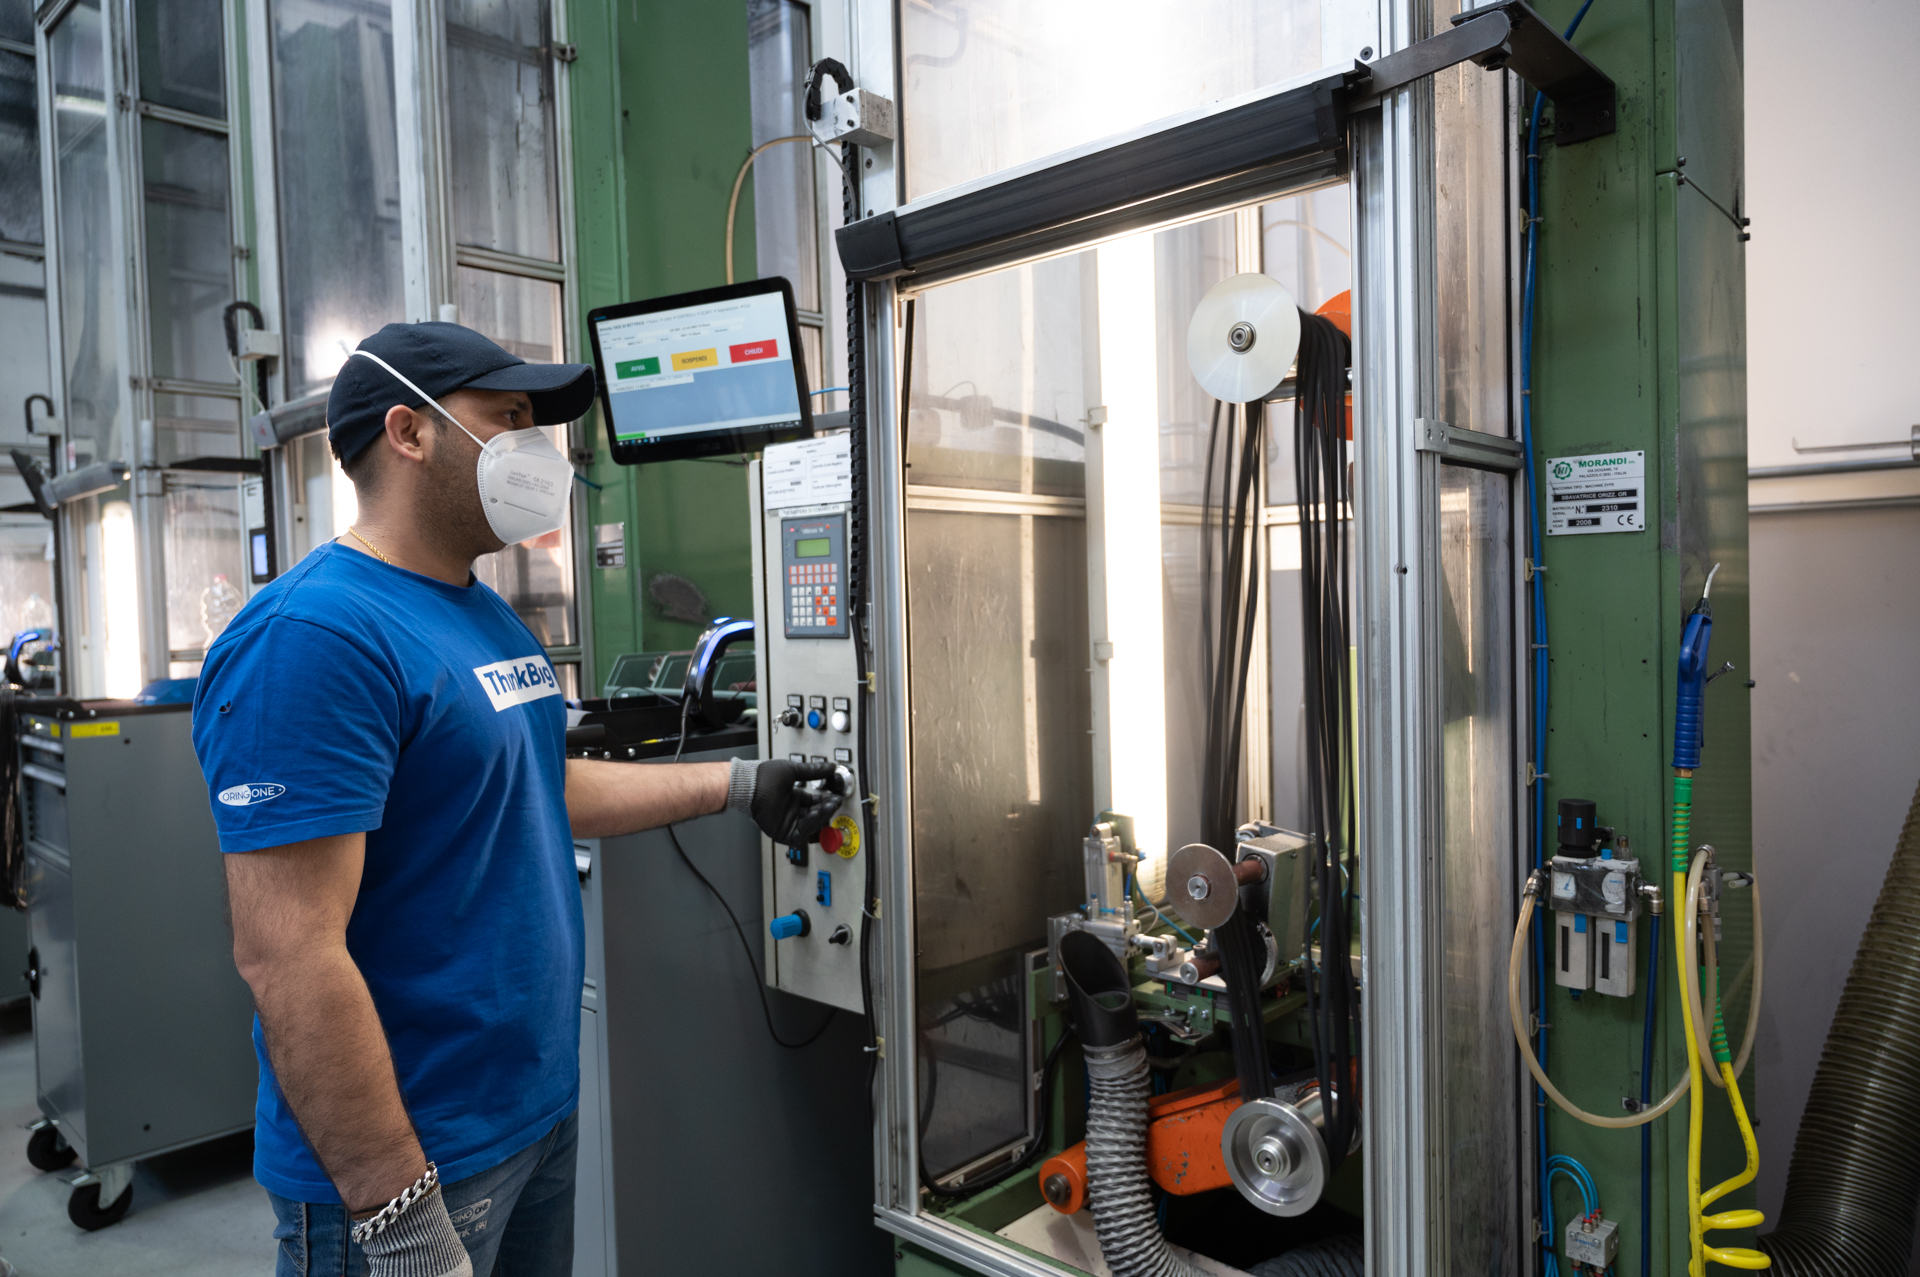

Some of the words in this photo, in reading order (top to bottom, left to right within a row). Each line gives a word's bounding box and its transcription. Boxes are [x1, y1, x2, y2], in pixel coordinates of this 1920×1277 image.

[681, 355, 707, 364] SOSPENDI
[631, 364, 646, 372] AVVIA
[1579, 457, 1627, 468] MORANDI
[1561, 492, 1596, 500] SBAVATRICE
